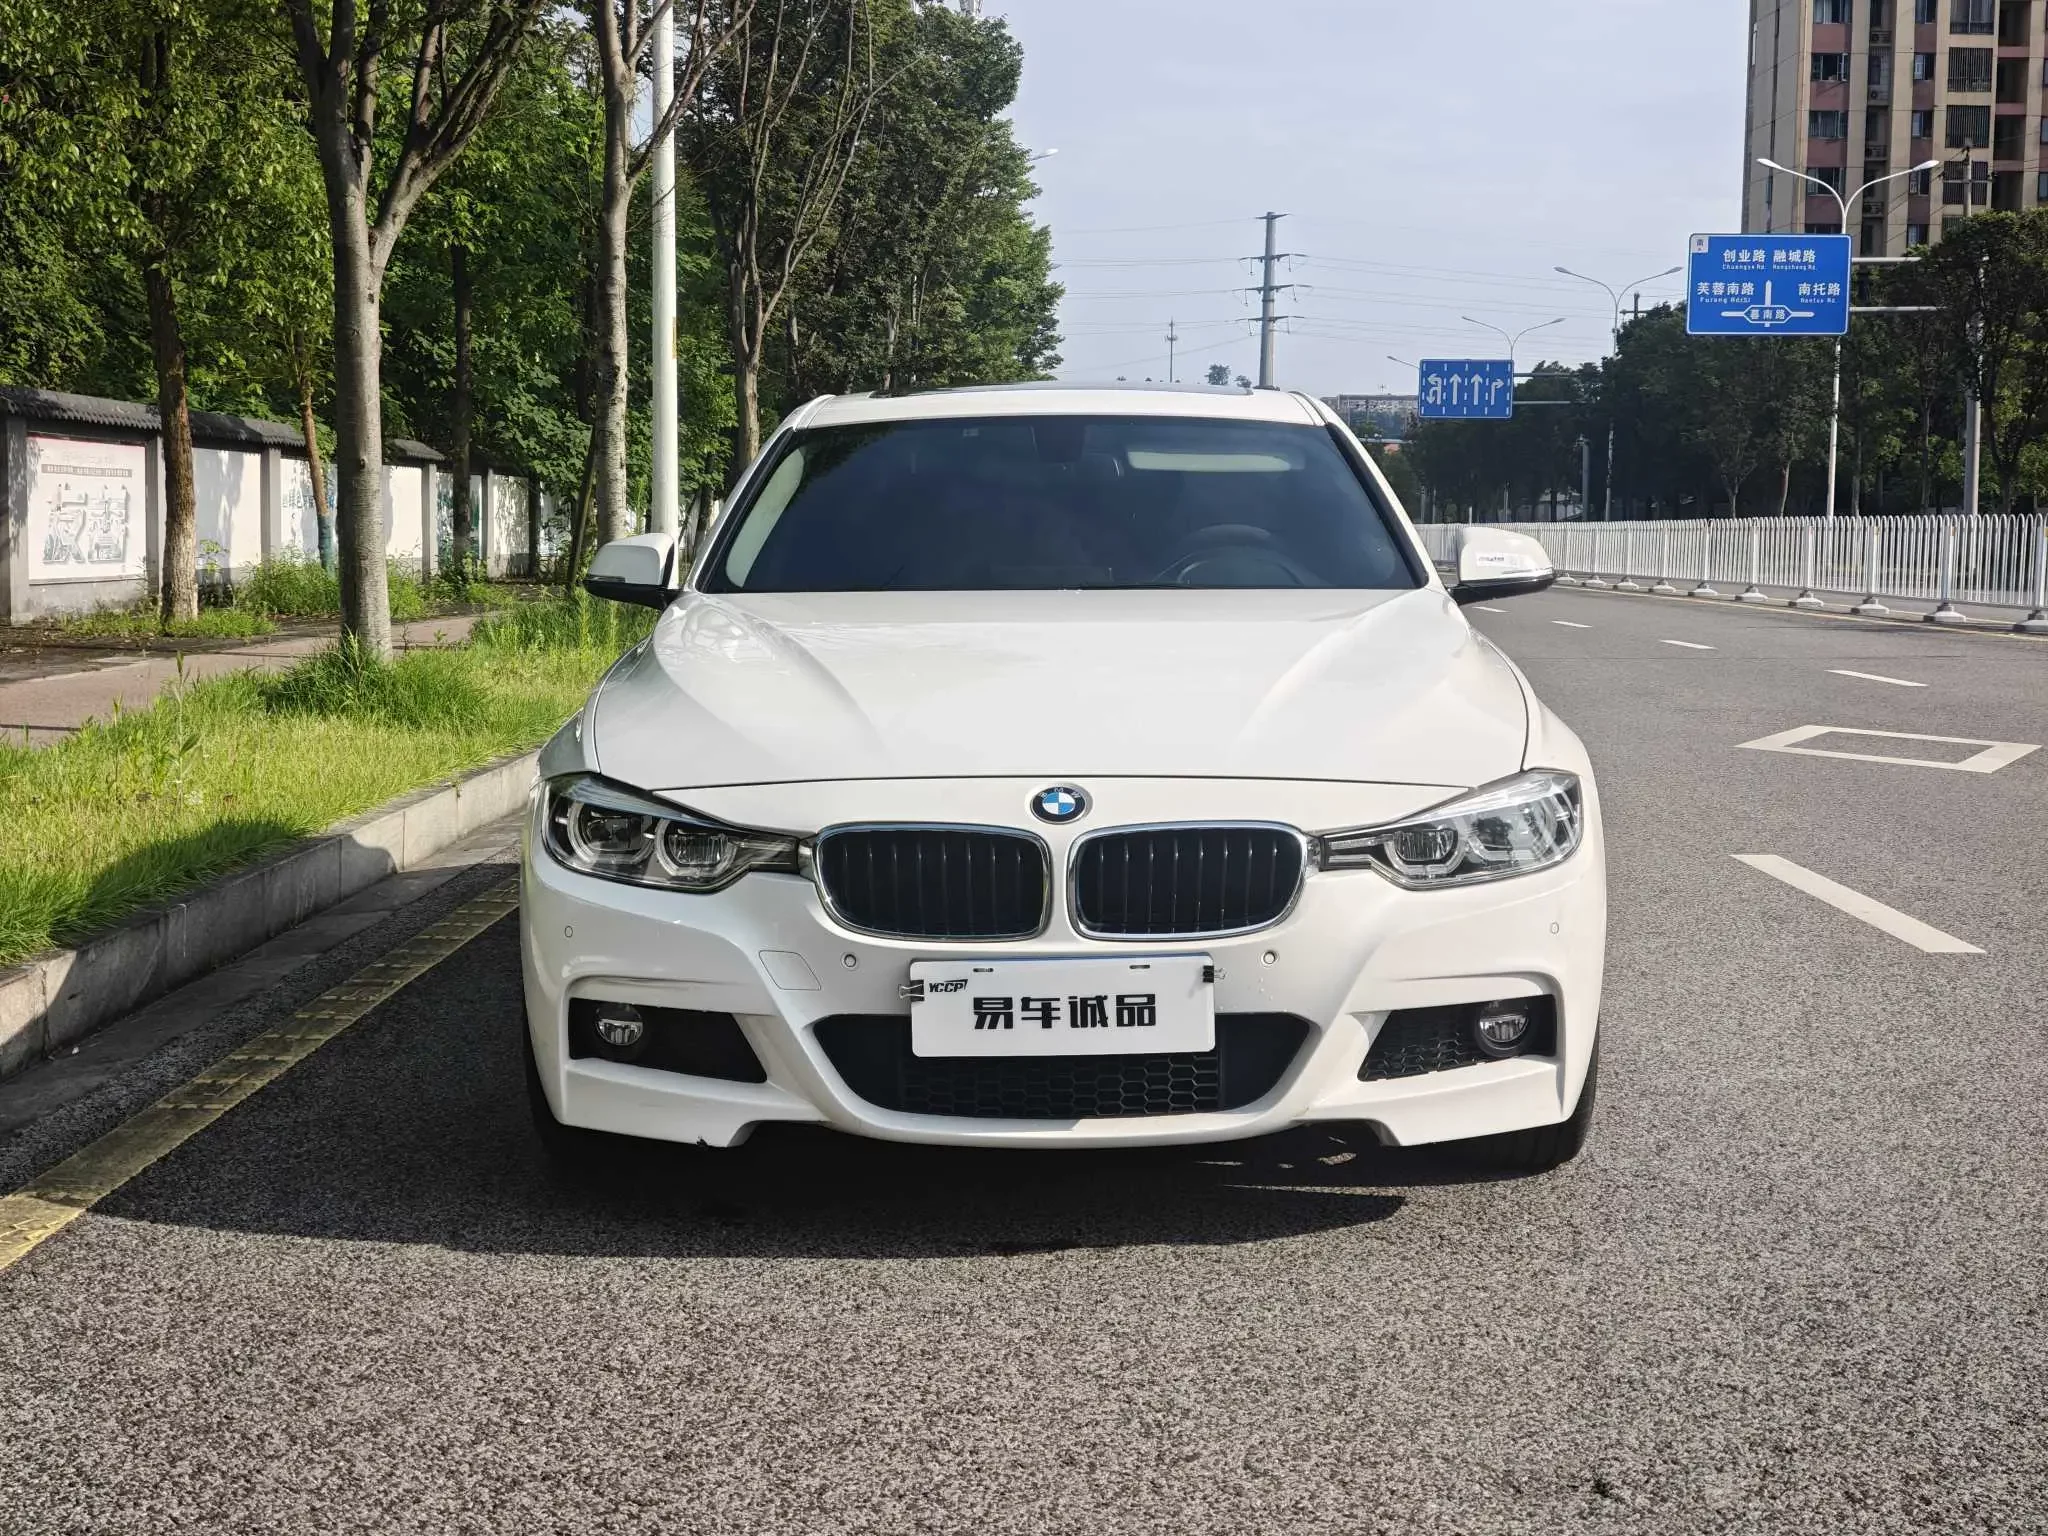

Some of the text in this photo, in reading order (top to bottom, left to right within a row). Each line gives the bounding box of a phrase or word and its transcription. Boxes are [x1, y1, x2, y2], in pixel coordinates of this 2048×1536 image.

[1723, 249, 1816, 263] 创业路 融城路
[1697, 282, 1755, 296] 芙蓉南路
[1798, 282, 1841, 296] 南托路
[1039, 787, 1081, 799] BMW
[929, 981, 966, 992] YCCP
[973, 994, 1156, 1030] 易车诚品
